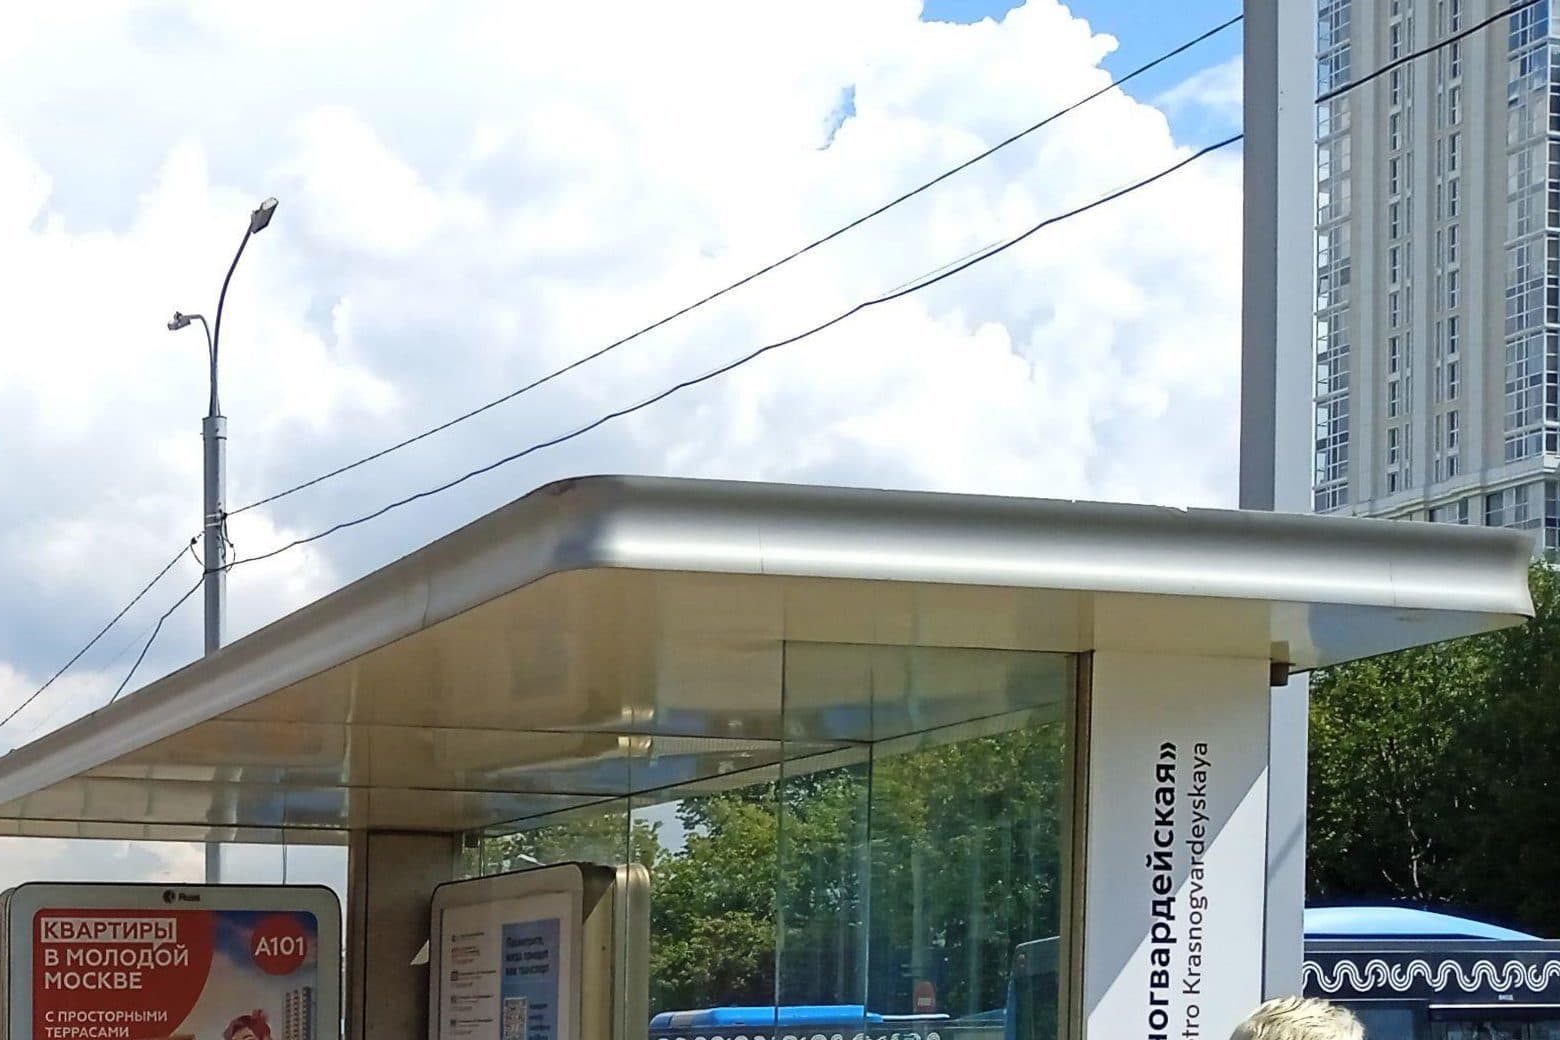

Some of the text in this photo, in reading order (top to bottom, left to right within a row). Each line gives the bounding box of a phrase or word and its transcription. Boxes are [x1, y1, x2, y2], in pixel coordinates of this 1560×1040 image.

[1182, 742, 1212, 994] Krasnogvardeyskaya
[43, 921, 174, 940] КВАРТИРЫ
[44, 944, 189, 970] В МОЛОДОЙ
[44, 972, 143, 990] МОСКВЕ
[44, 1010, 168, 1023] С ПРОСТОРНЫМИ
[44, 1026, 130, 1039] ТЕРРАСАМИ
